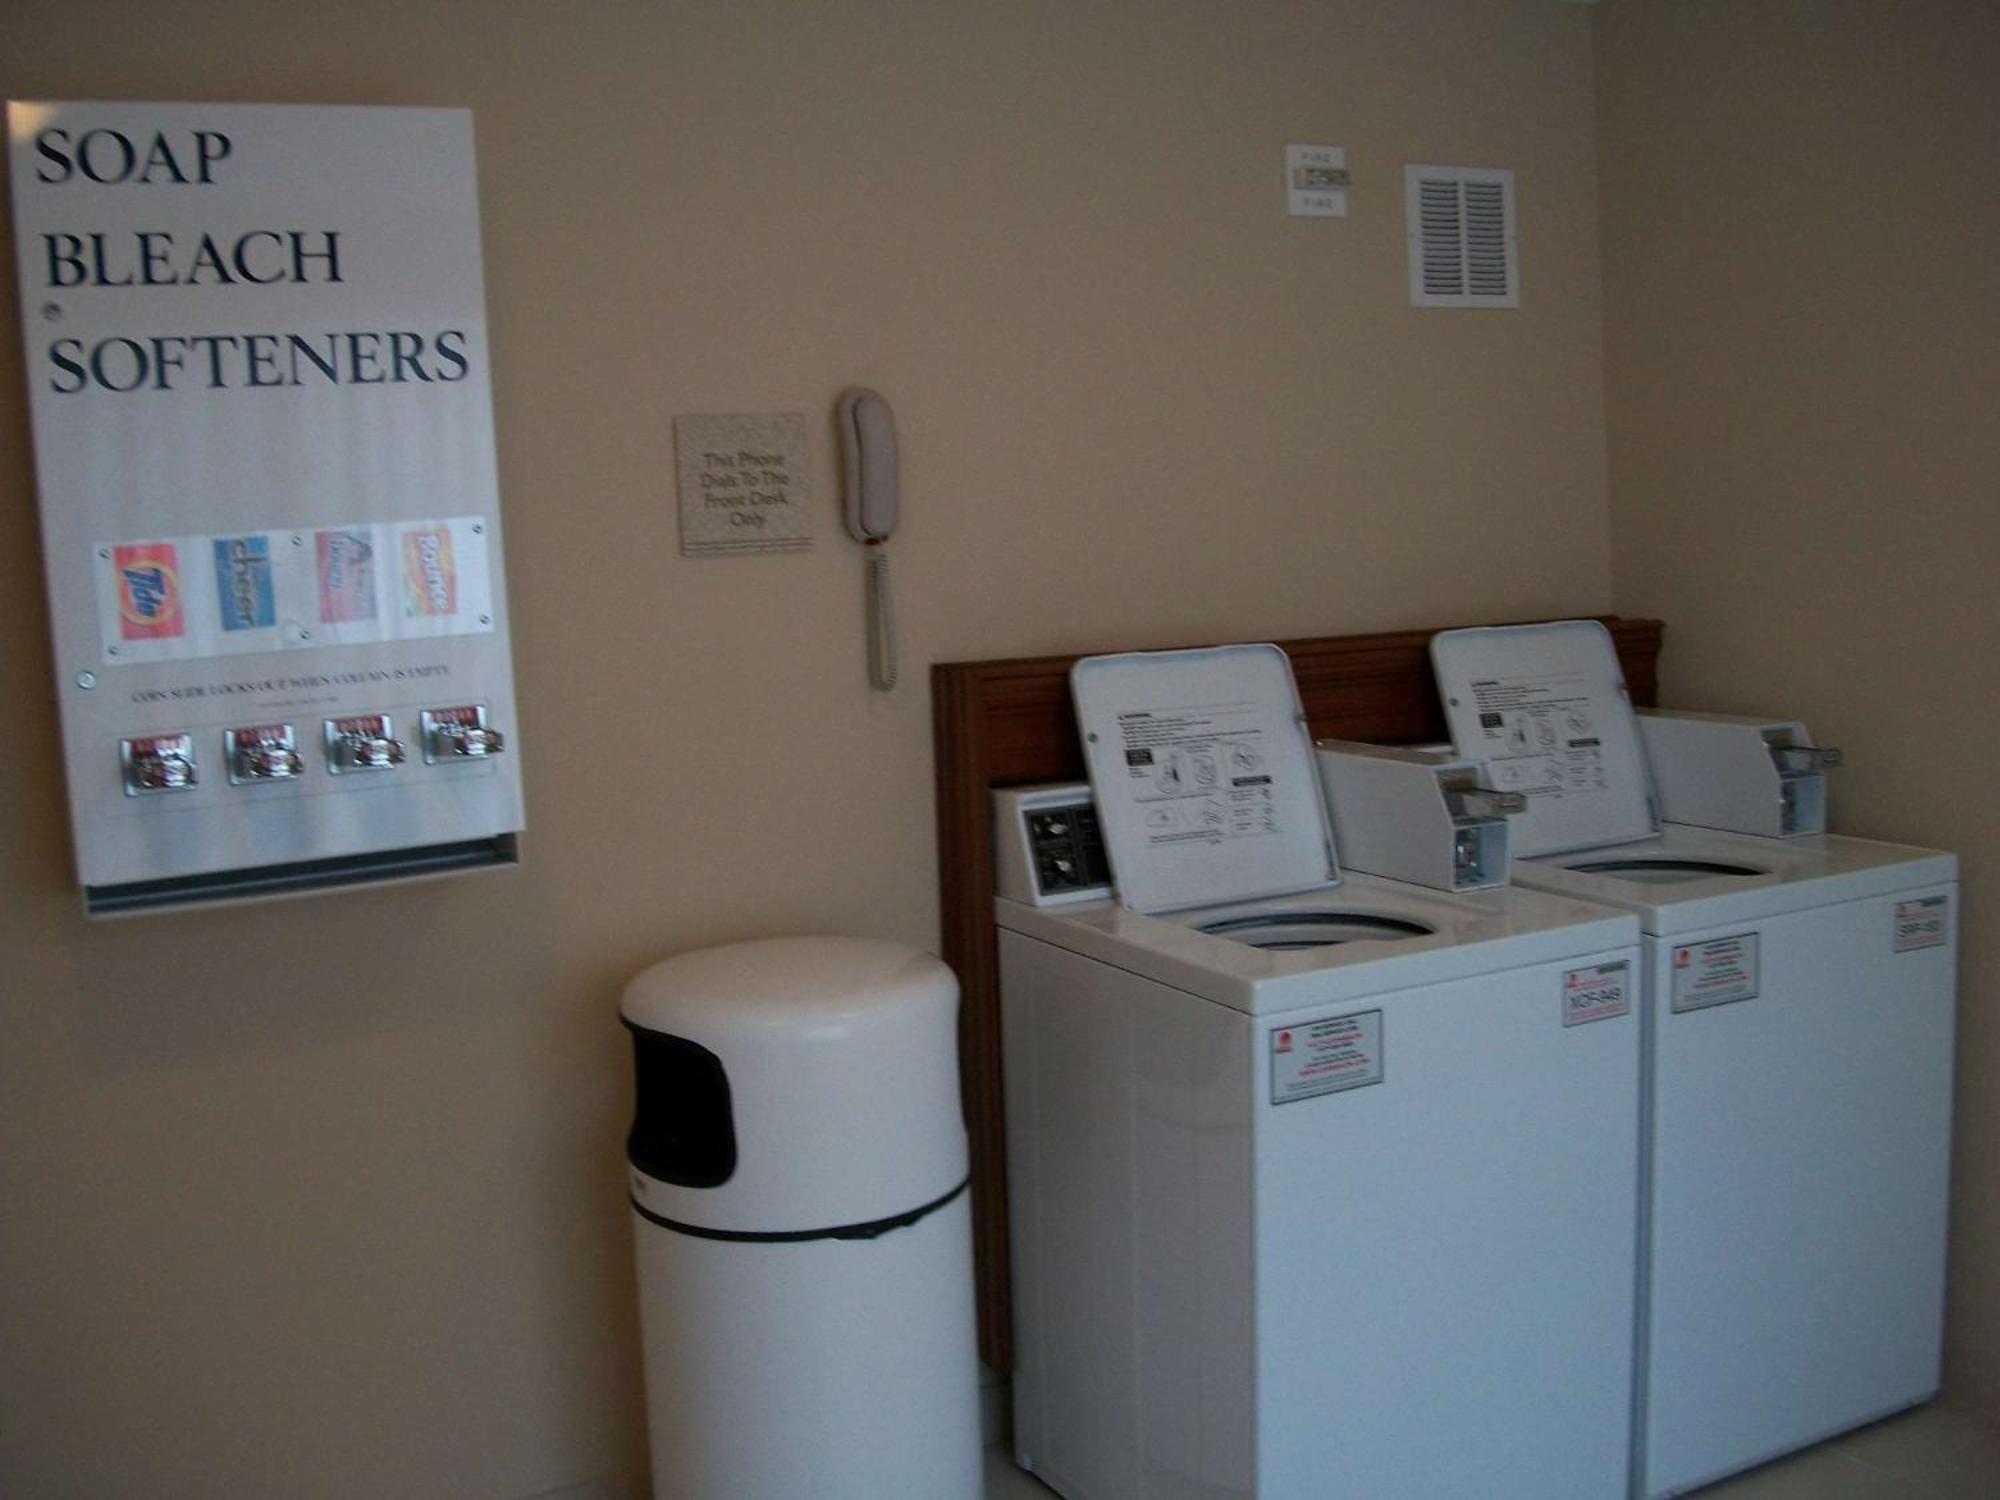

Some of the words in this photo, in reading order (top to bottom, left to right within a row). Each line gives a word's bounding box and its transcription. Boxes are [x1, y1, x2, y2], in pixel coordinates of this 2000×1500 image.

[36, 127, 232, 185] SOAP
[42, 230, 344, 287] BLEACH
[48, 330, 470, 394] SOFTENERS
[123, 566, 166, 617] Tide
[416, 533, 449, 611] Bounce
